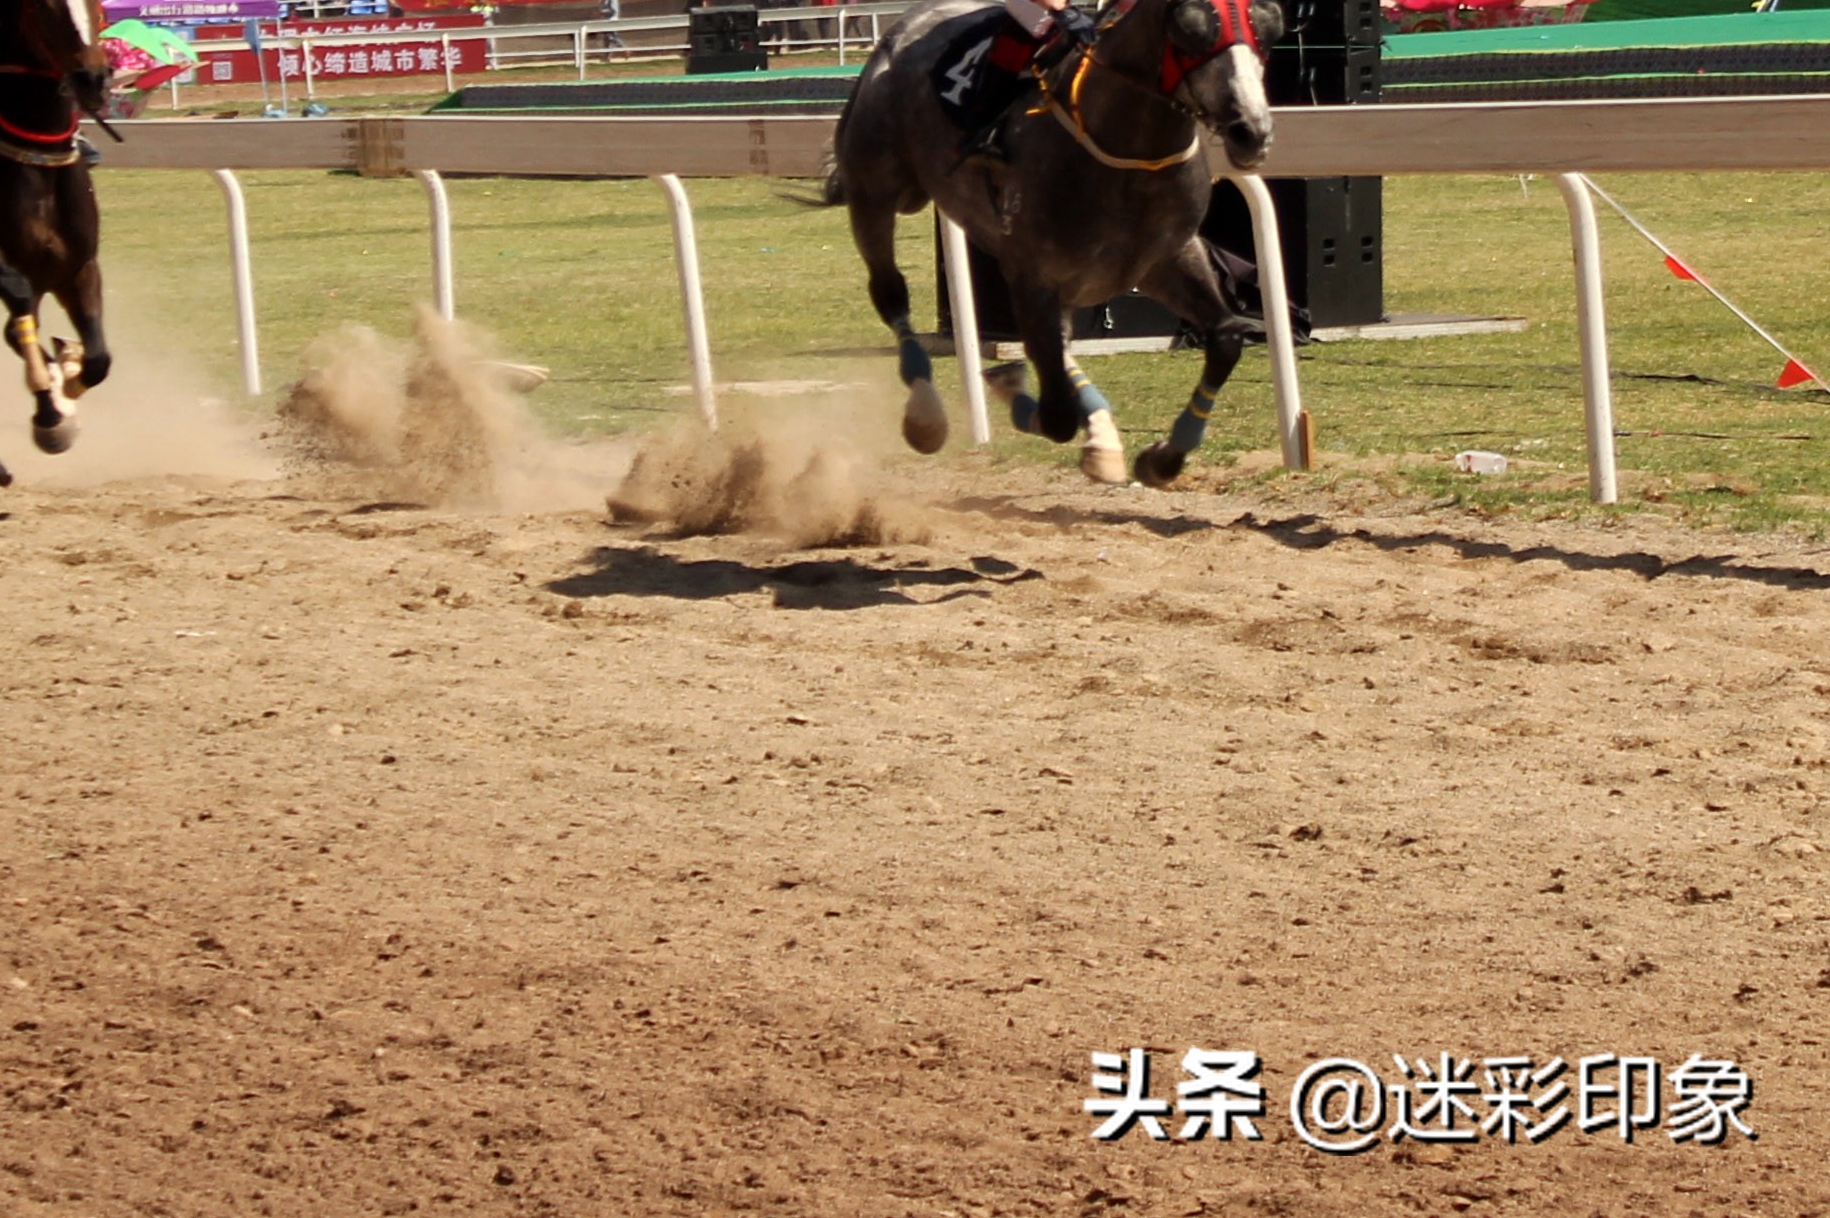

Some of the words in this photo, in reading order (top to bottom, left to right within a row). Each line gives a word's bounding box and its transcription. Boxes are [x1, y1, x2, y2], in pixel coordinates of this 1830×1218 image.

[278, 46, 463, 77] 倾心缔造城市繁华
[940, 36, 993, 106] 4
